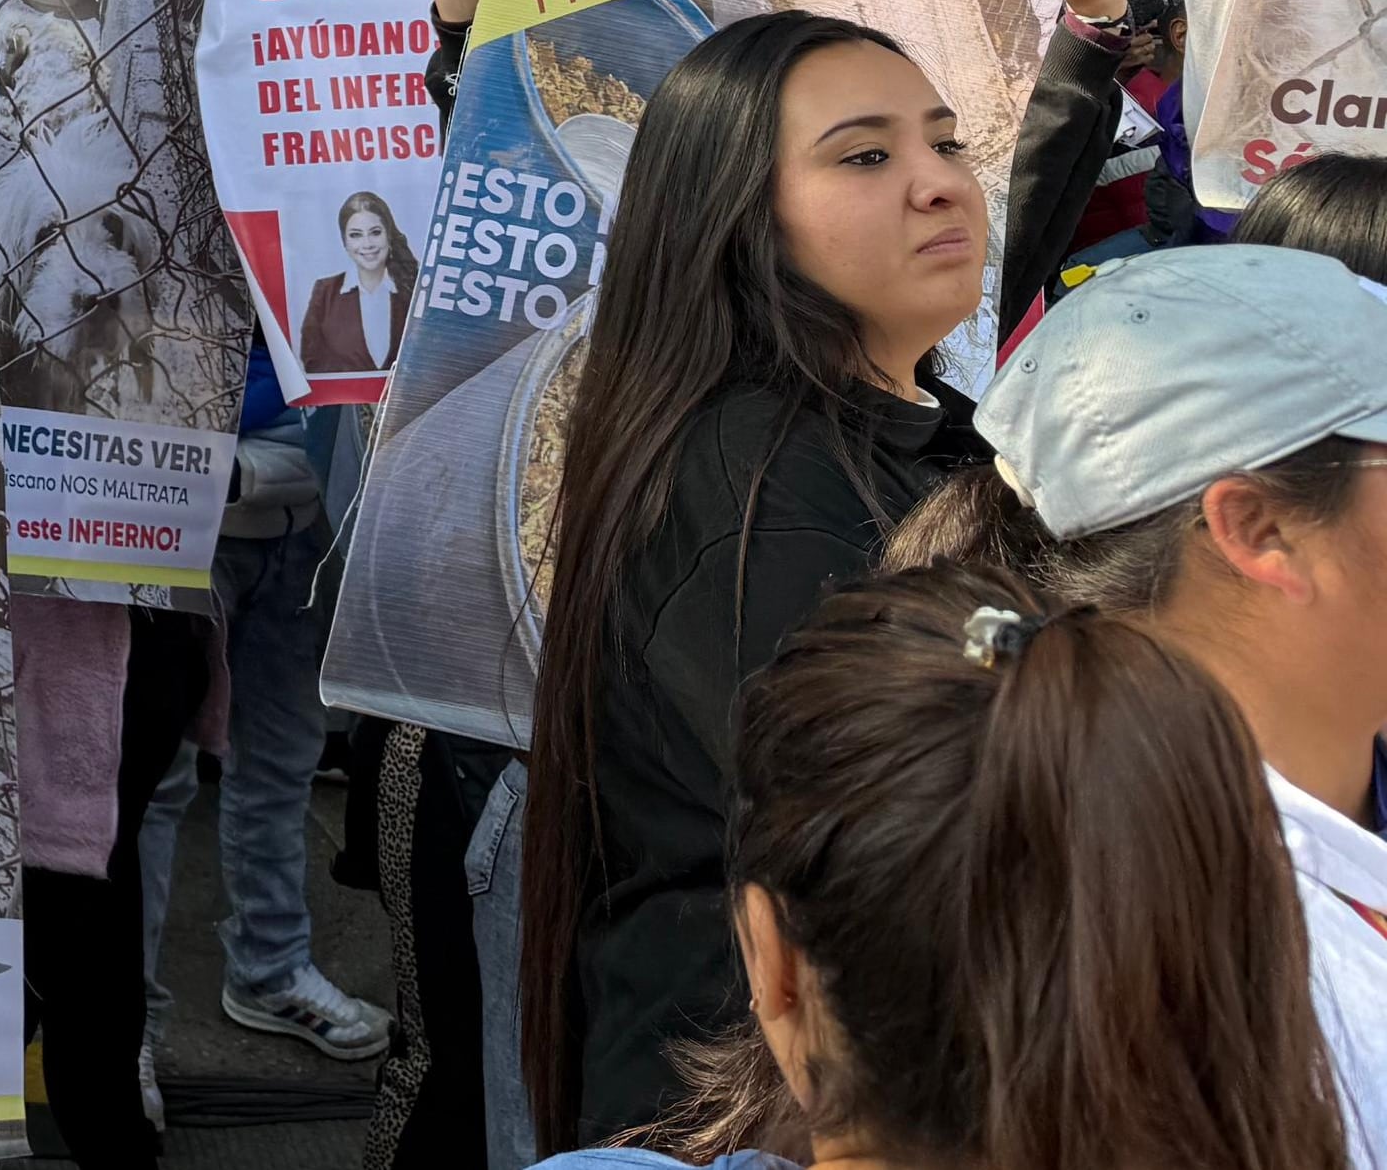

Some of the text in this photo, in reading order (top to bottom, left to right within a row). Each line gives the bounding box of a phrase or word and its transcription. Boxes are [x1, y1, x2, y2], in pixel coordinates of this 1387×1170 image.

[252, 18, 437, 66] ¡AYÚDANO
[258, 72, 427, 114] DEL INFER
[1270, 78, 1387, 130] Clar
[263, 123, 435, 167] FRANCISC
[437, 161, 586, 228] ¡ESTO
[426, 213, 577, 279] ¡ESTO
[413, 264, 568, 330] ¡ESTO
[2, 422, 212, 476] NECESITAS VER!
[4, 468, 189, 506] iscano NOS MALTRATA
[17, 517, 182, 553] este INFIERNO!
